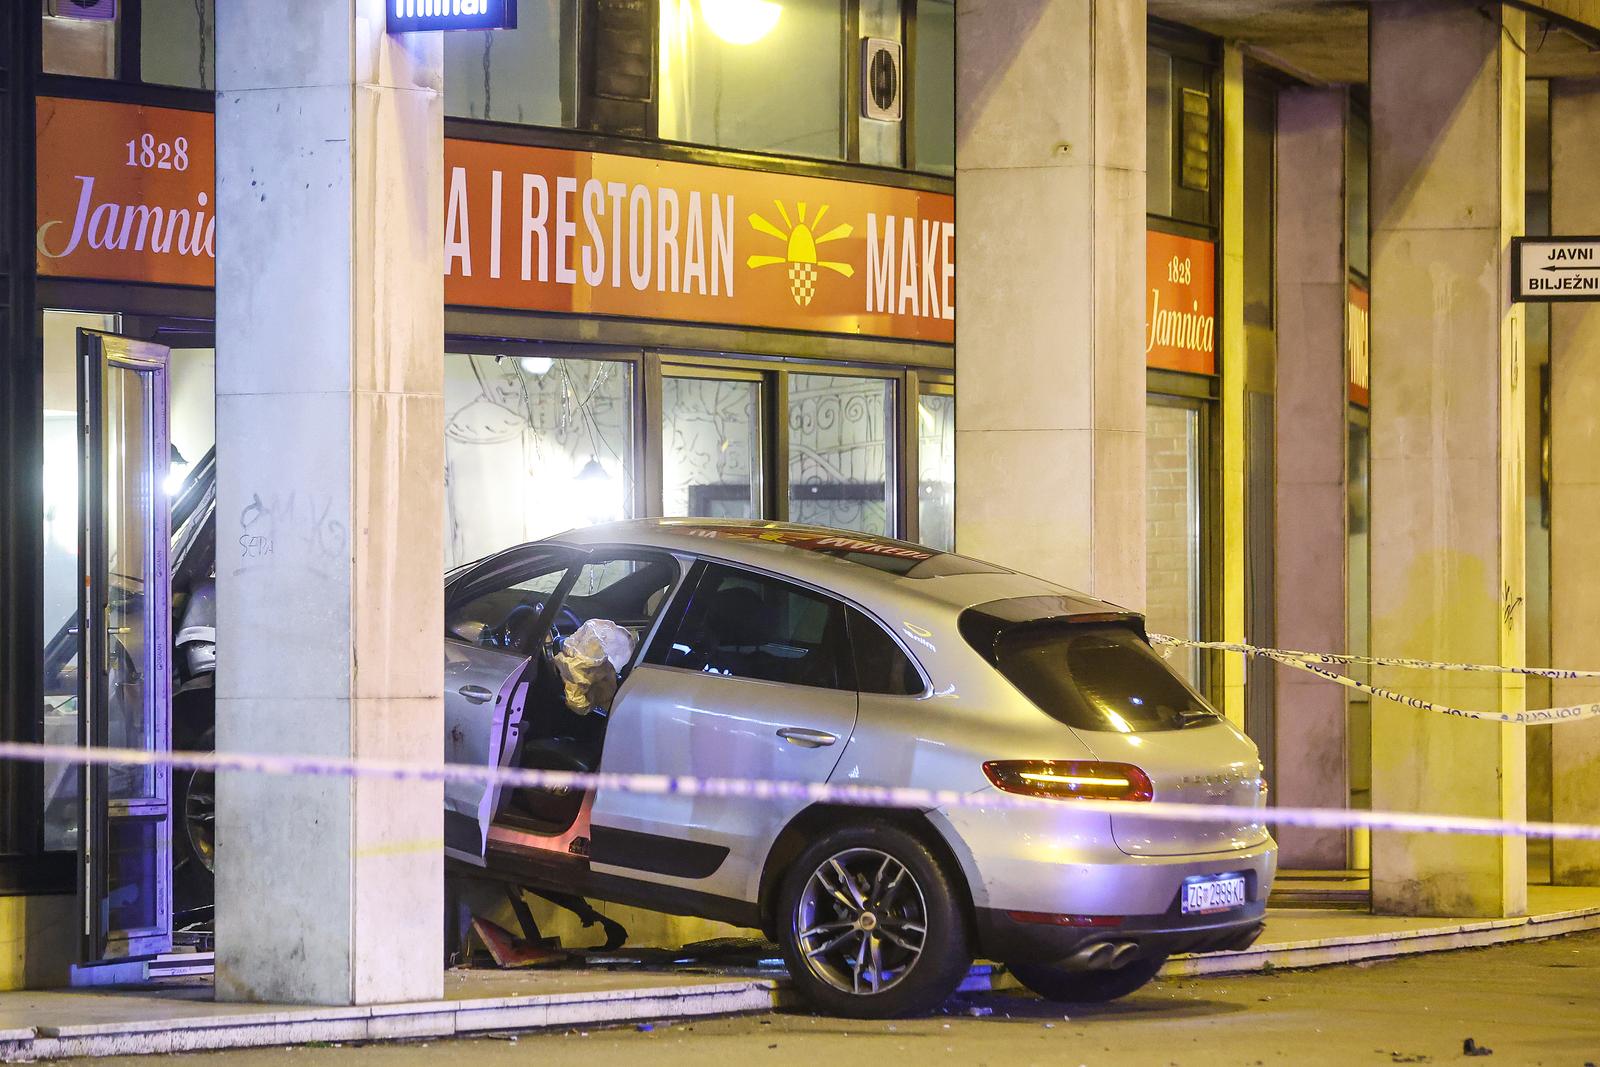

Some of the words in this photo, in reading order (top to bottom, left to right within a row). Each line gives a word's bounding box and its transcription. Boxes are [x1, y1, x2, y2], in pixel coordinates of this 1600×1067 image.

[126, 133, 189, 171] 1828
[490, 170, 502, 279] I
[521, 172, 735, 297] RESTORAN
[1168, 255, 1191, 285] 1828
[1548, 248, 1593, 260] JAVNI
[1529, 274, 1600, 290] BILJEŽNI
[1146, 288, 1214, 352] Jamnica
